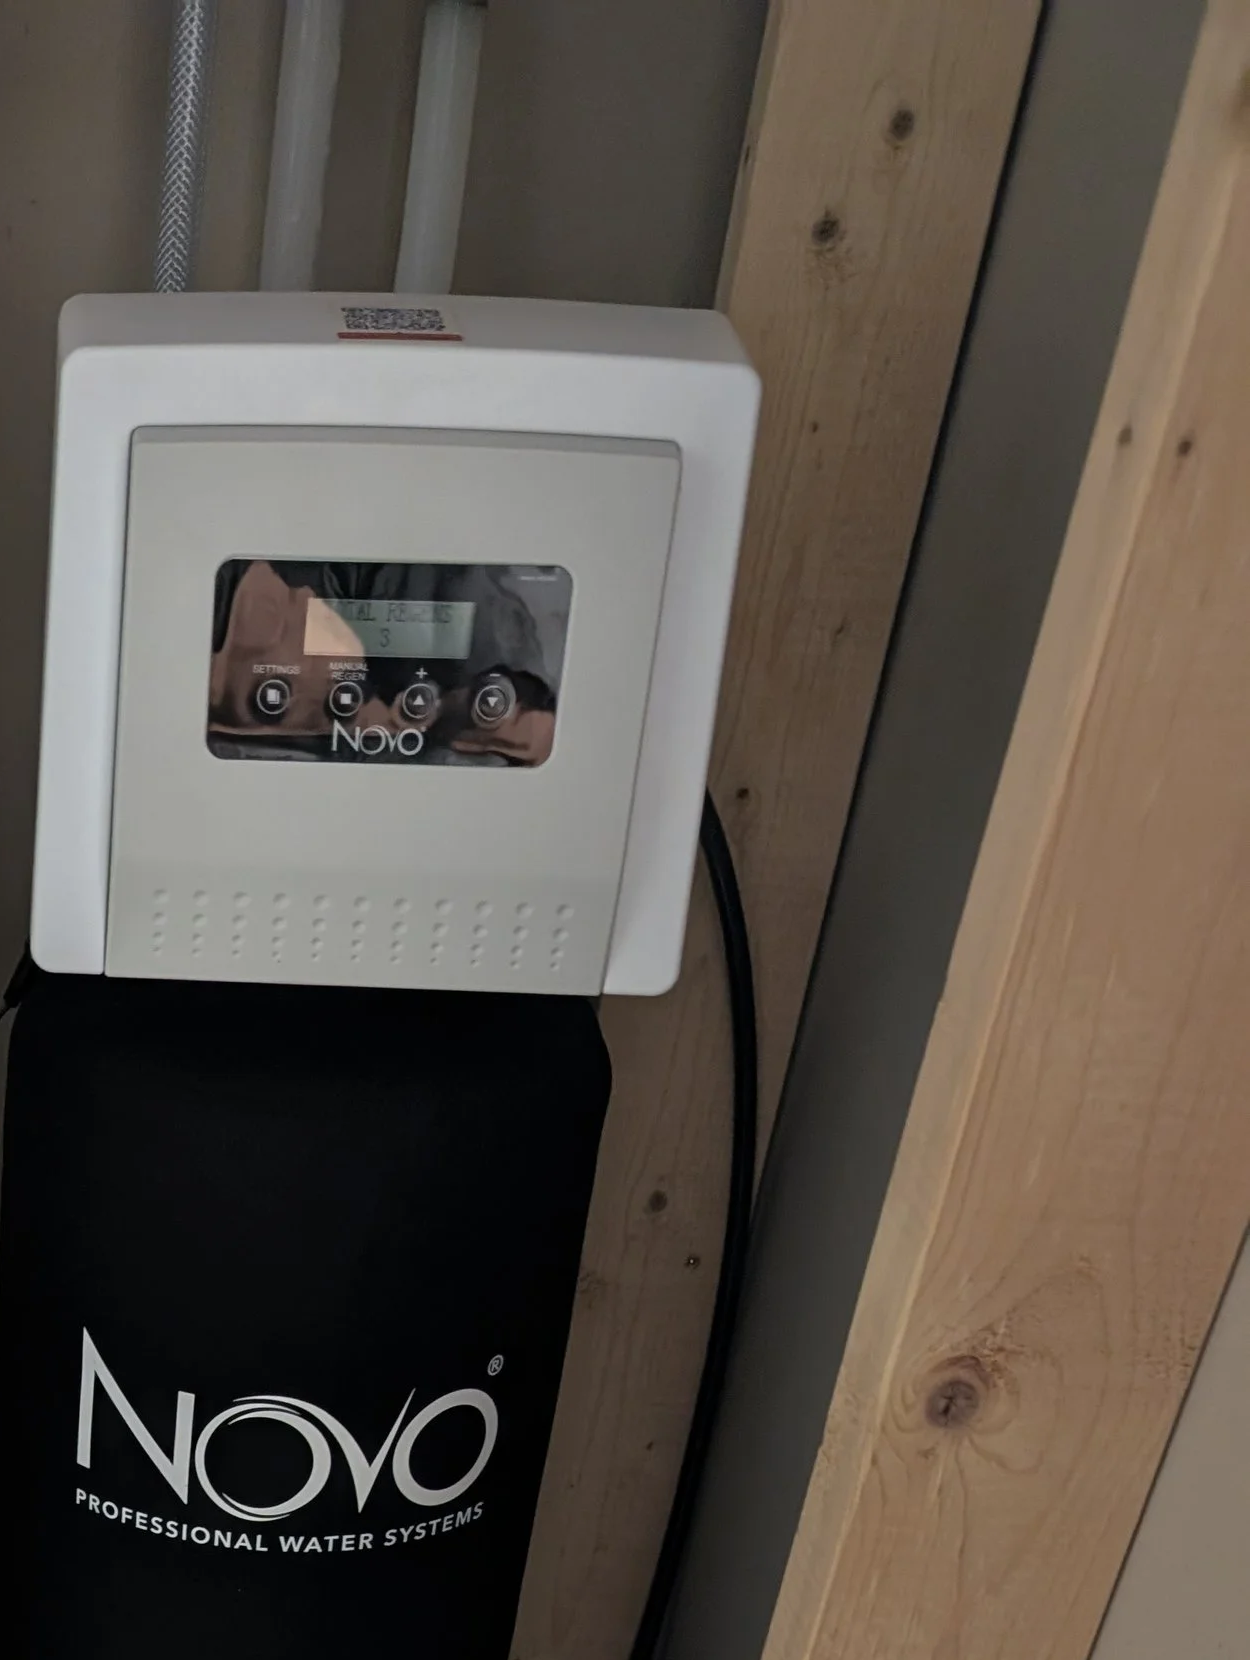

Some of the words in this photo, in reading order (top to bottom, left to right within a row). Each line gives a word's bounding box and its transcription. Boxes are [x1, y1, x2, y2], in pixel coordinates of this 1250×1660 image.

[379, 628, 391, 648] 3
[252, 664, 301, 675] SETTINGS
[329, 662, 370, 672] MANUAL
[330, 671, 367, 681] REGEN
[75, 1487, 268, 1553] PROFESSIONAL
[278, 1532, 374, 1554] WATER
[382, 1501, 485, 1548] SYSTEMS
